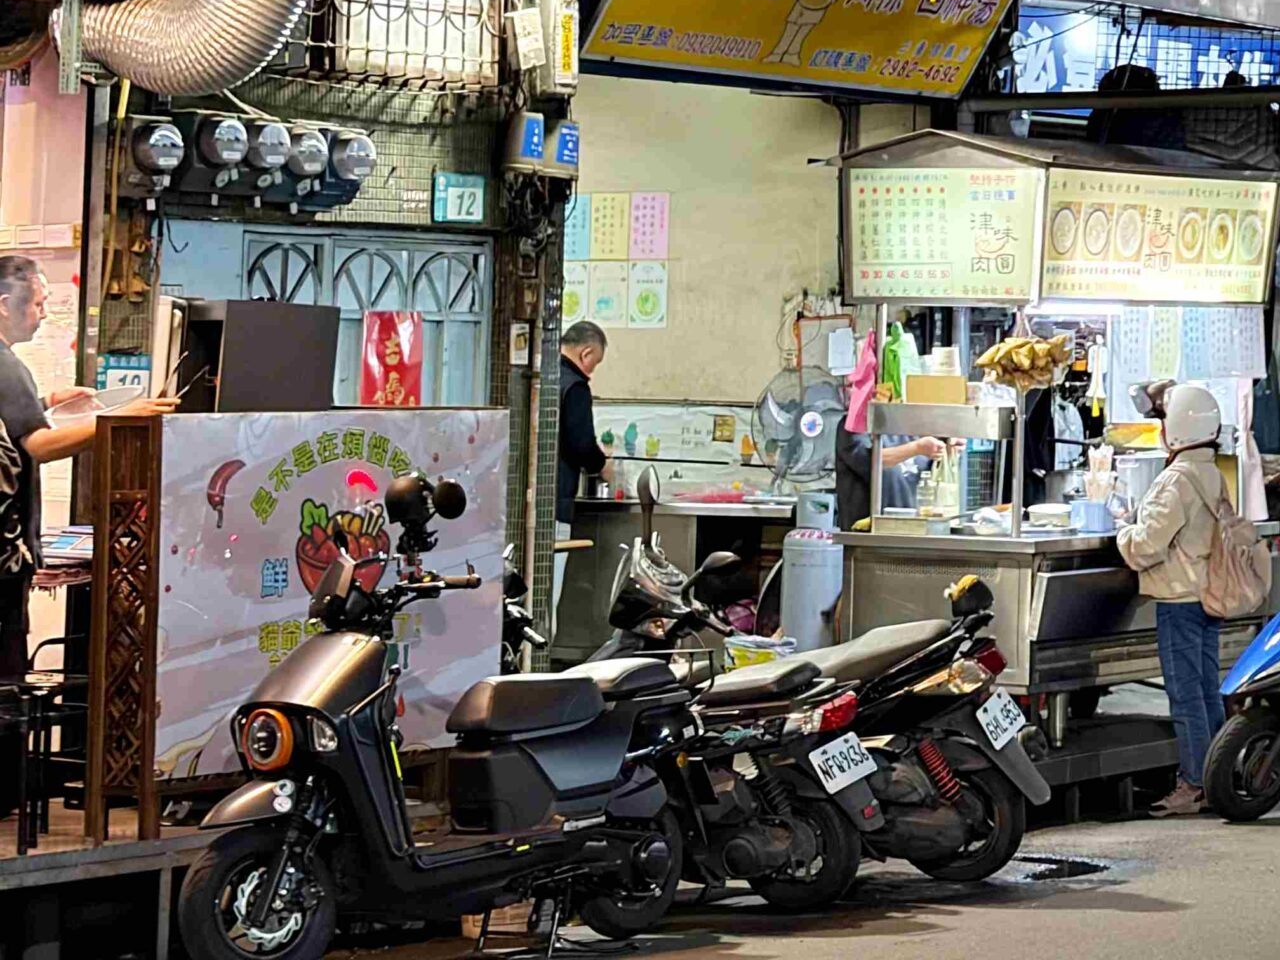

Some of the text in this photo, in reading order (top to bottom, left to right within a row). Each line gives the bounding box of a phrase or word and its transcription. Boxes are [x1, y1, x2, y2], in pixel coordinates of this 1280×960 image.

[457, 191, 476, 216] 12
[971, 253, 1016, 276] 肉圓
[250, 426, 426, 525] 是不是在煩惱吃
